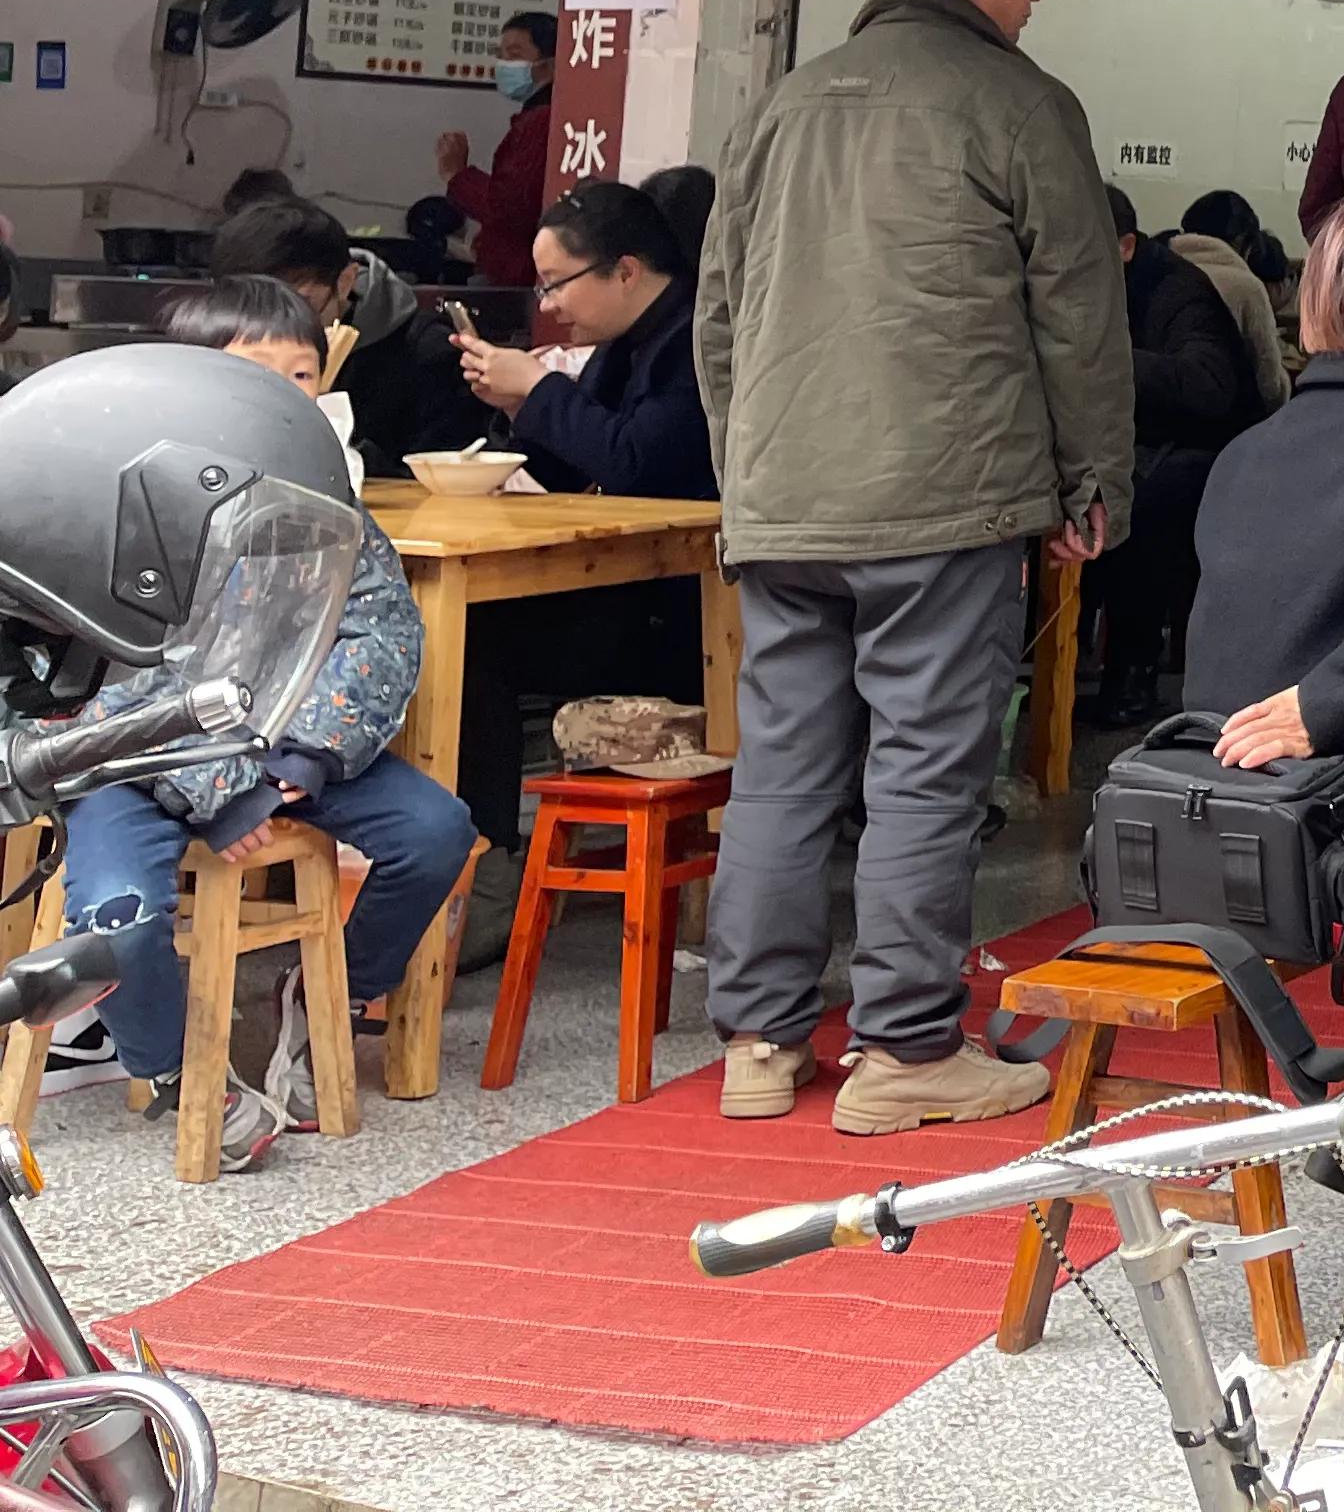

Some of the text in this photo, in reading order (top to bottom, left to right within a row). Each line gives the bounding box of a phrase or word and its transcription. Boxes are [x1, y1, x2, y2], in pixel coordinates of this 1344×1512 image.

[569, 8, 616, 70] 炸
[560, 119, 607, 200] 冰
[1120, 143, 1172, 166] 内有监控
[1286, 141, 1318, 163] 小心
